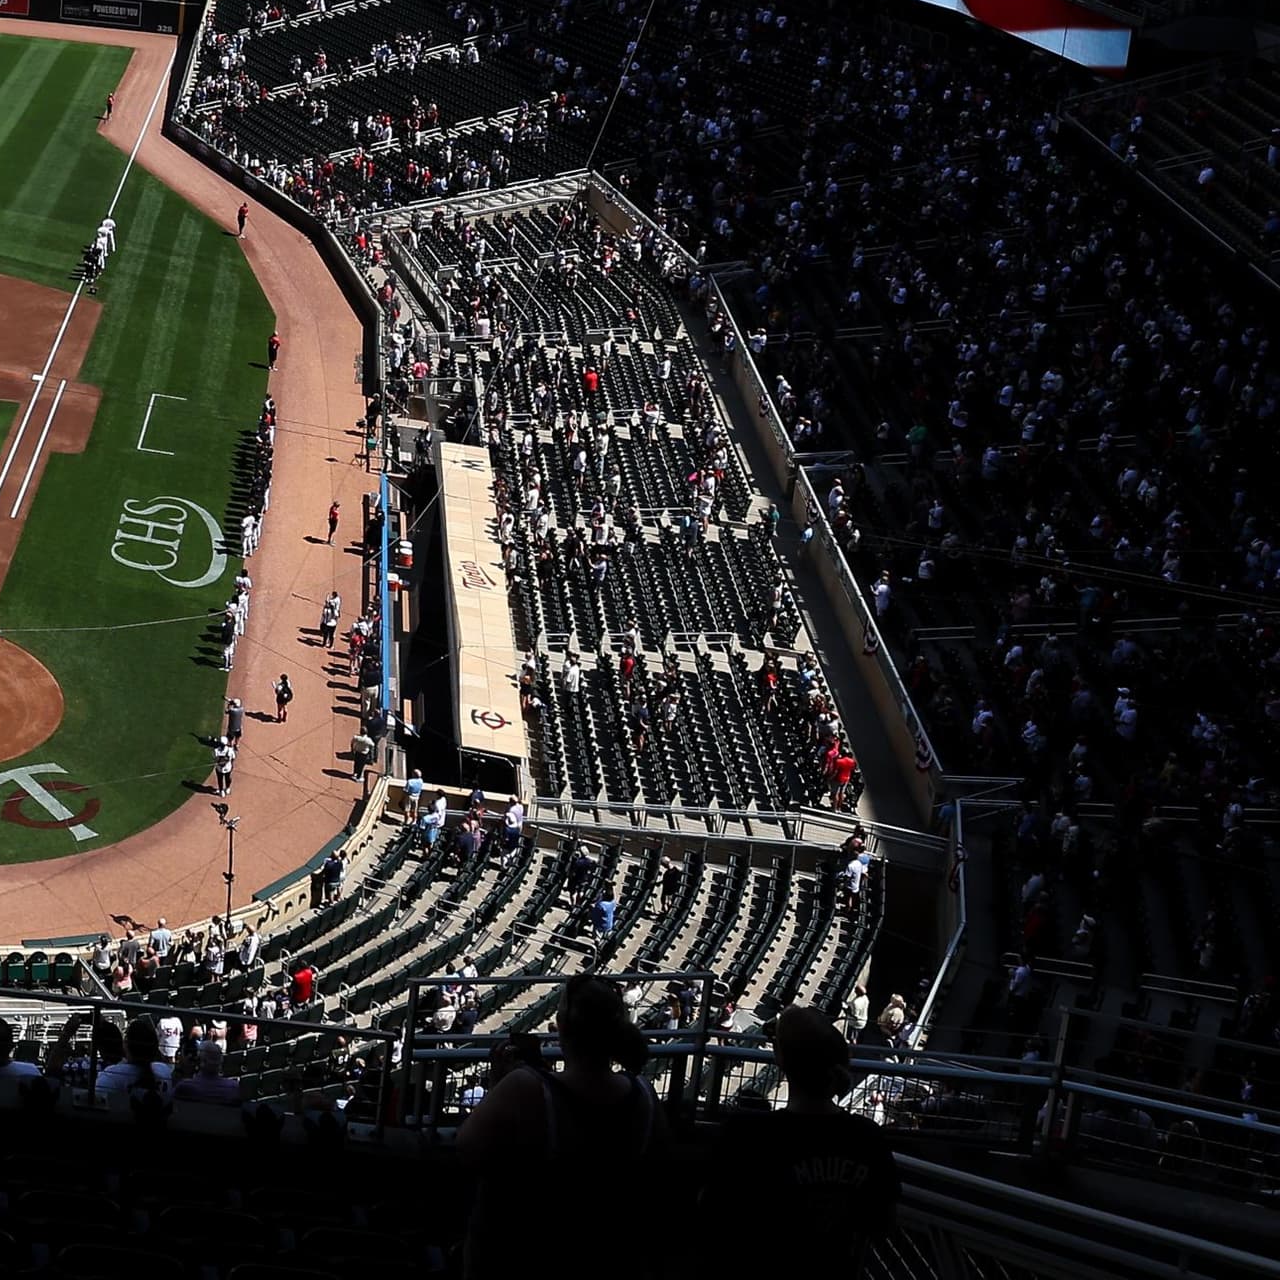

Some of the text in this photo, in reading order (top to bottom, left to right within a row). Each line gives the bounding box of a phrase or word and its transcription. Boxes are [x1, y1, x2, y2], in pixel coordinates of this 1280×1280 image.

[92, 3, 120, 15] POWERED
[127, 7, 139, 17] YOU
[111, 498, 189, 571] CHS
[459, 560, 493, 590] Twins
